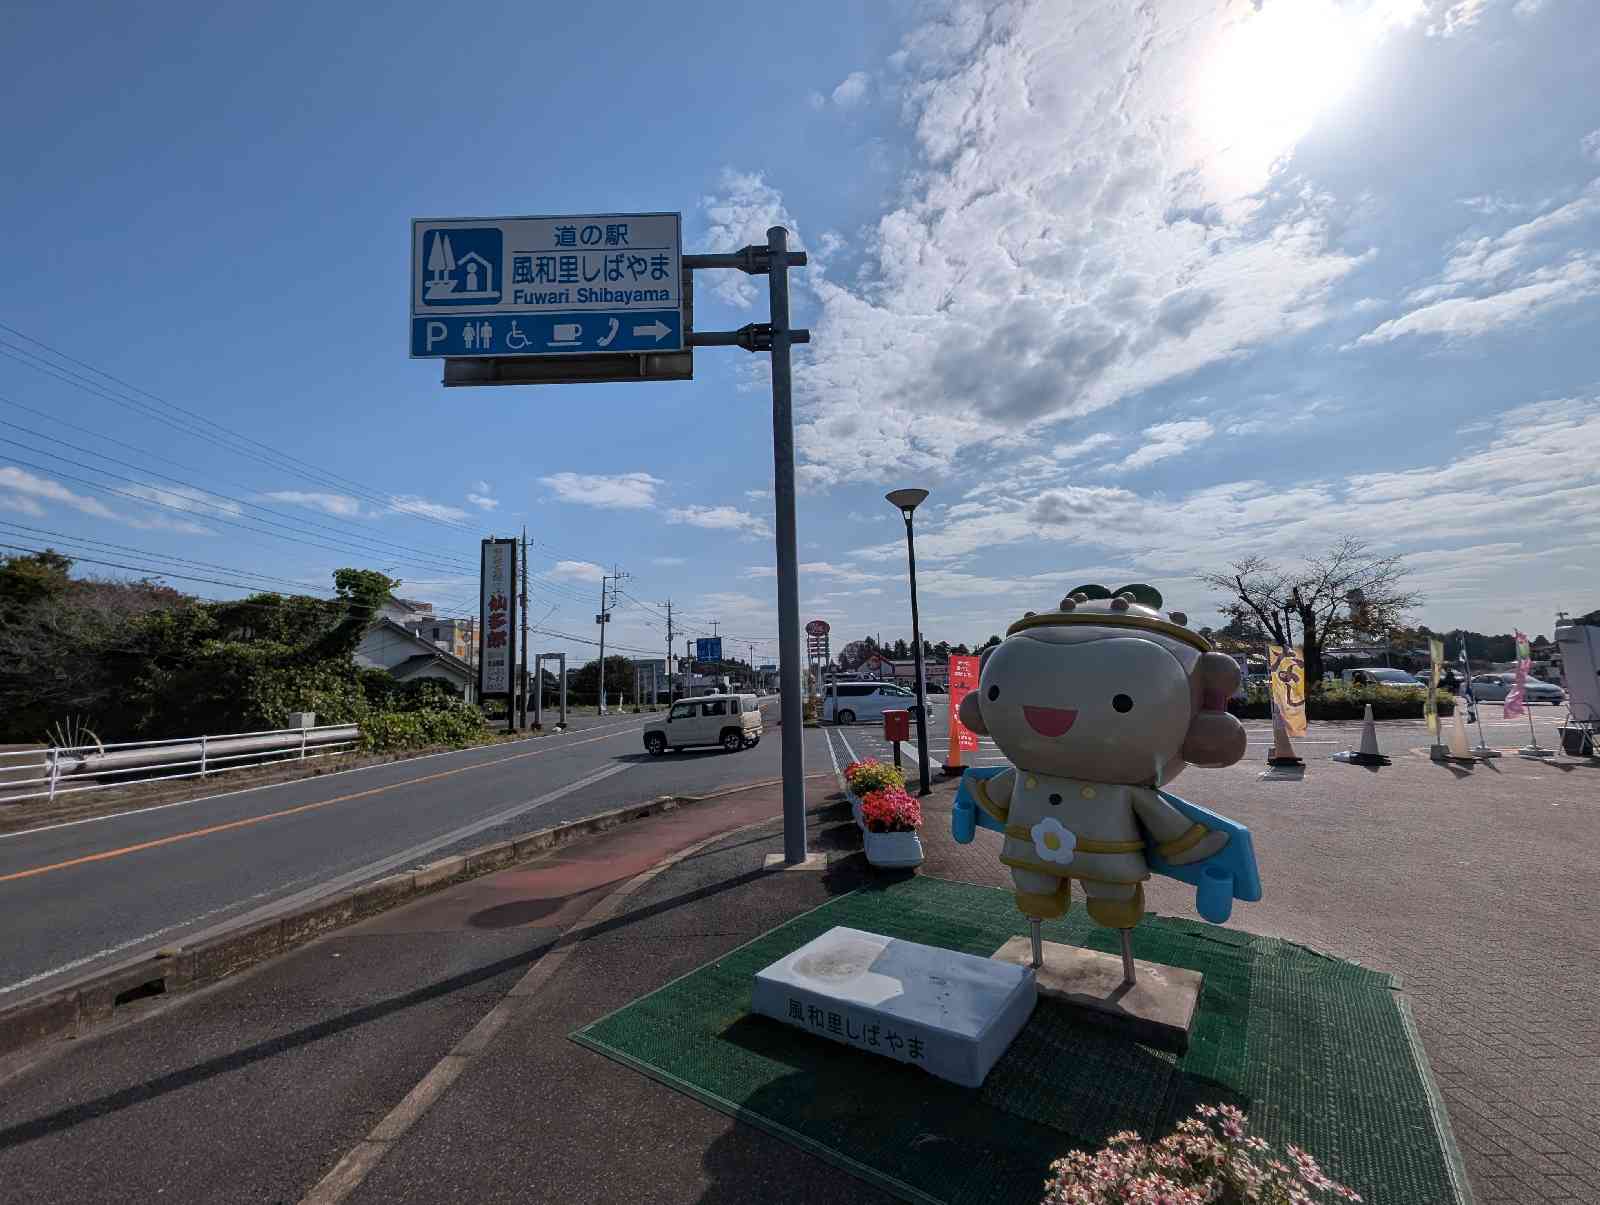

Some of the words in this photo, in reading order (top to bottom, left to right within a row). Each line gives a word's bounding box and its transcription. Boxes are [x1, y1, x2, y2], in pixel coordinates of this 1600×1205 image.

[554, 223, 629, 247] 道の駅
[511, 254, 670, 285] 風和里しばやま
[513, 289, 570, 305] Fuwari
[577, 287, 670, 305] Shibayama
[426, 321, 448, 351] P
[786, 998, 926, 1060] 風和里しばやま
